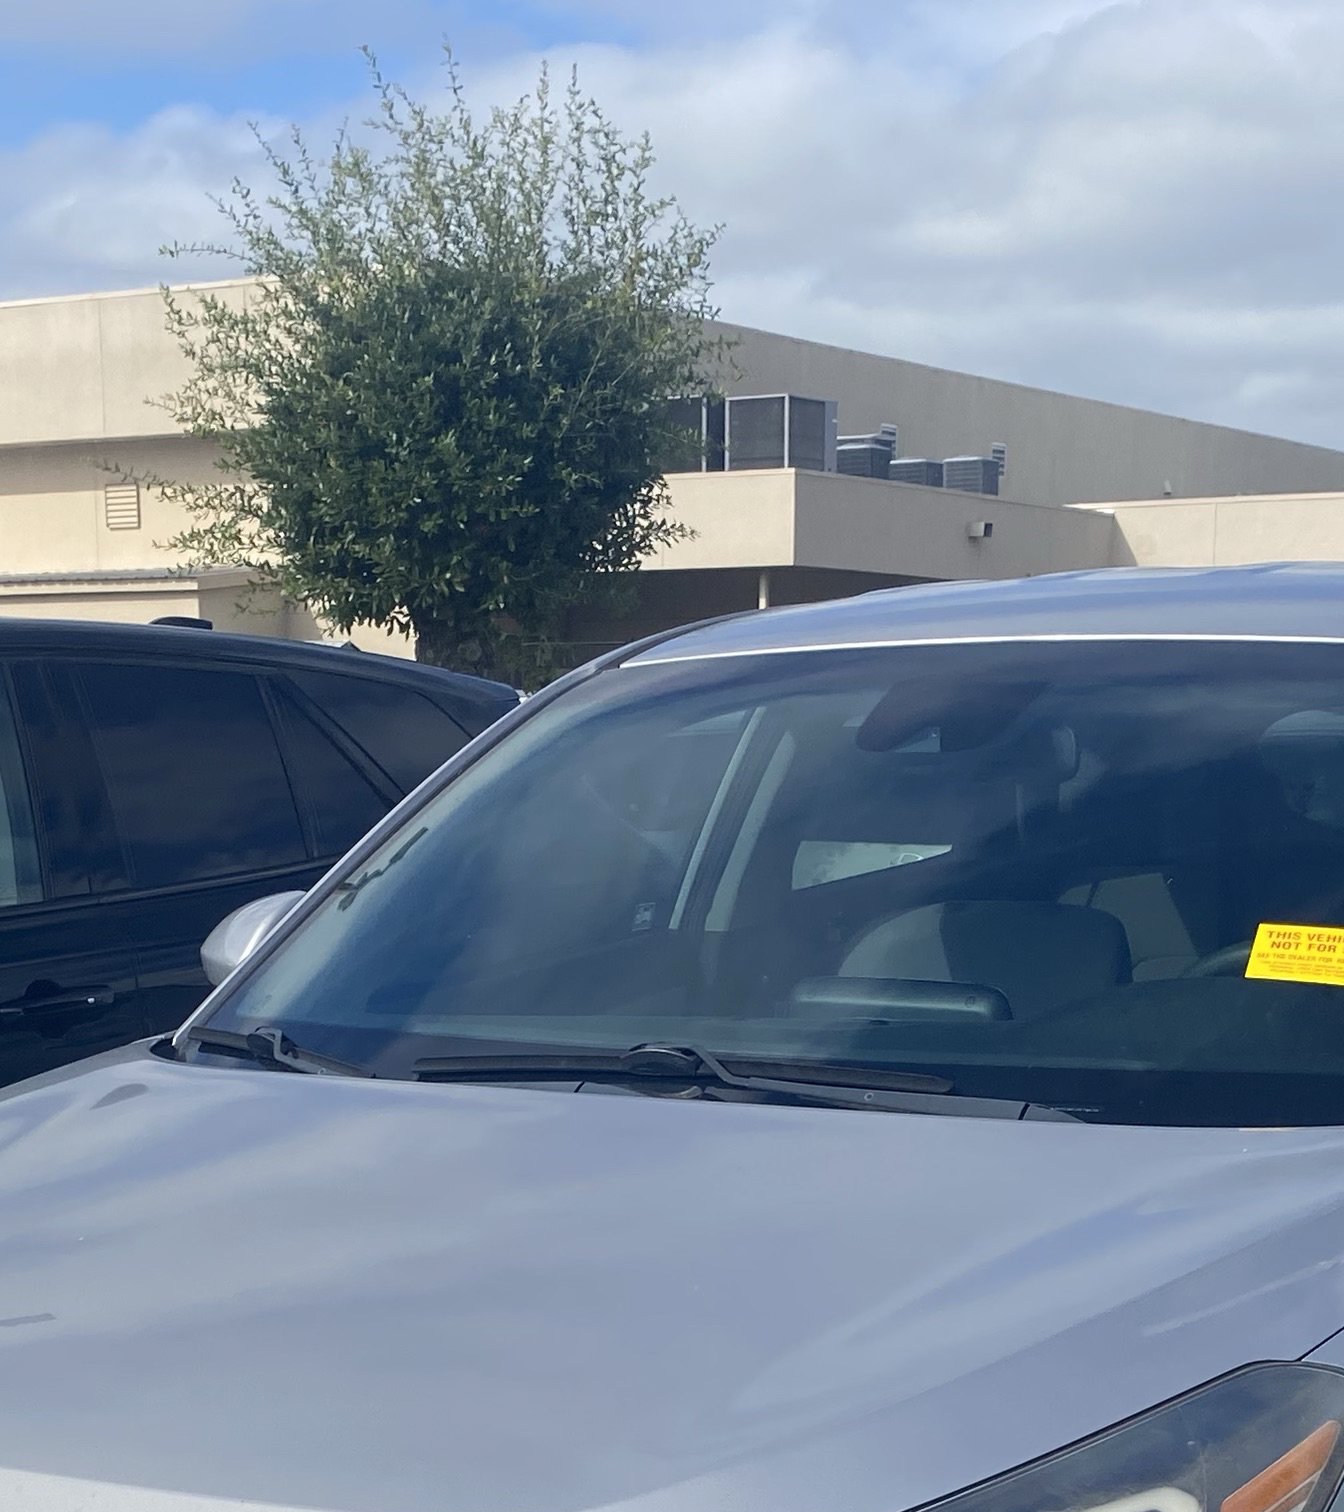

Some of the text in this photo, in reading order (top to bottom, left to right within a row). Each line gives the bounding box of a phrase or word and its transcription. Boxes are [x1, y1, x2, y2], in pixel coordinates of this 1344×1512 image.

[1267, 930, 1302, 941] THIS
[1270, 941, 1302, 951] NOT
[1307, 943, 1337, 953] FOR
[1287, 954, 1317, 962] DEALER
